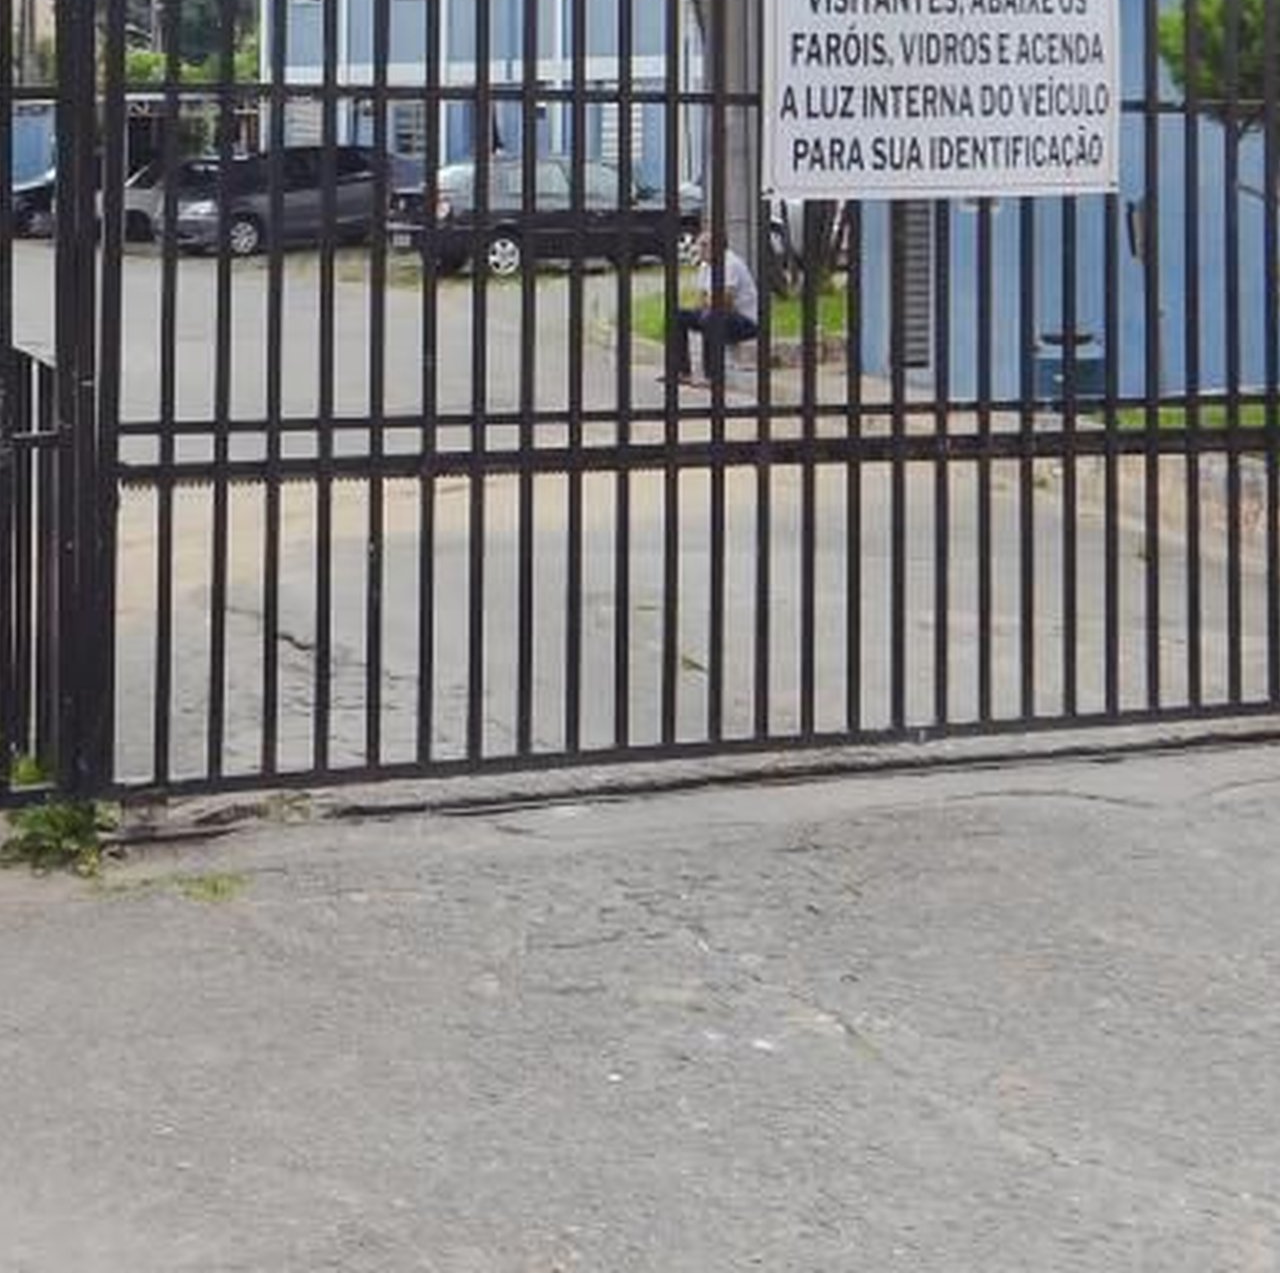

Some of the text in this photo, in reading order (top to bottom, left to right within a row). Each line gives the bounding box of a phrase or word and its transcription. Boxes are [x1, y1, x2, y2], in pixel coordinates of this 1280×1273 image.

[792, 24, 1103, 67] FARÓIS, VIDROS E ACENDA
[781, 77, 1109, 120] A LUZ INTERNA DO VEÍCULO
[793, 125, 1102, 172] PARA SUA IDENTIFICAÇÃO
